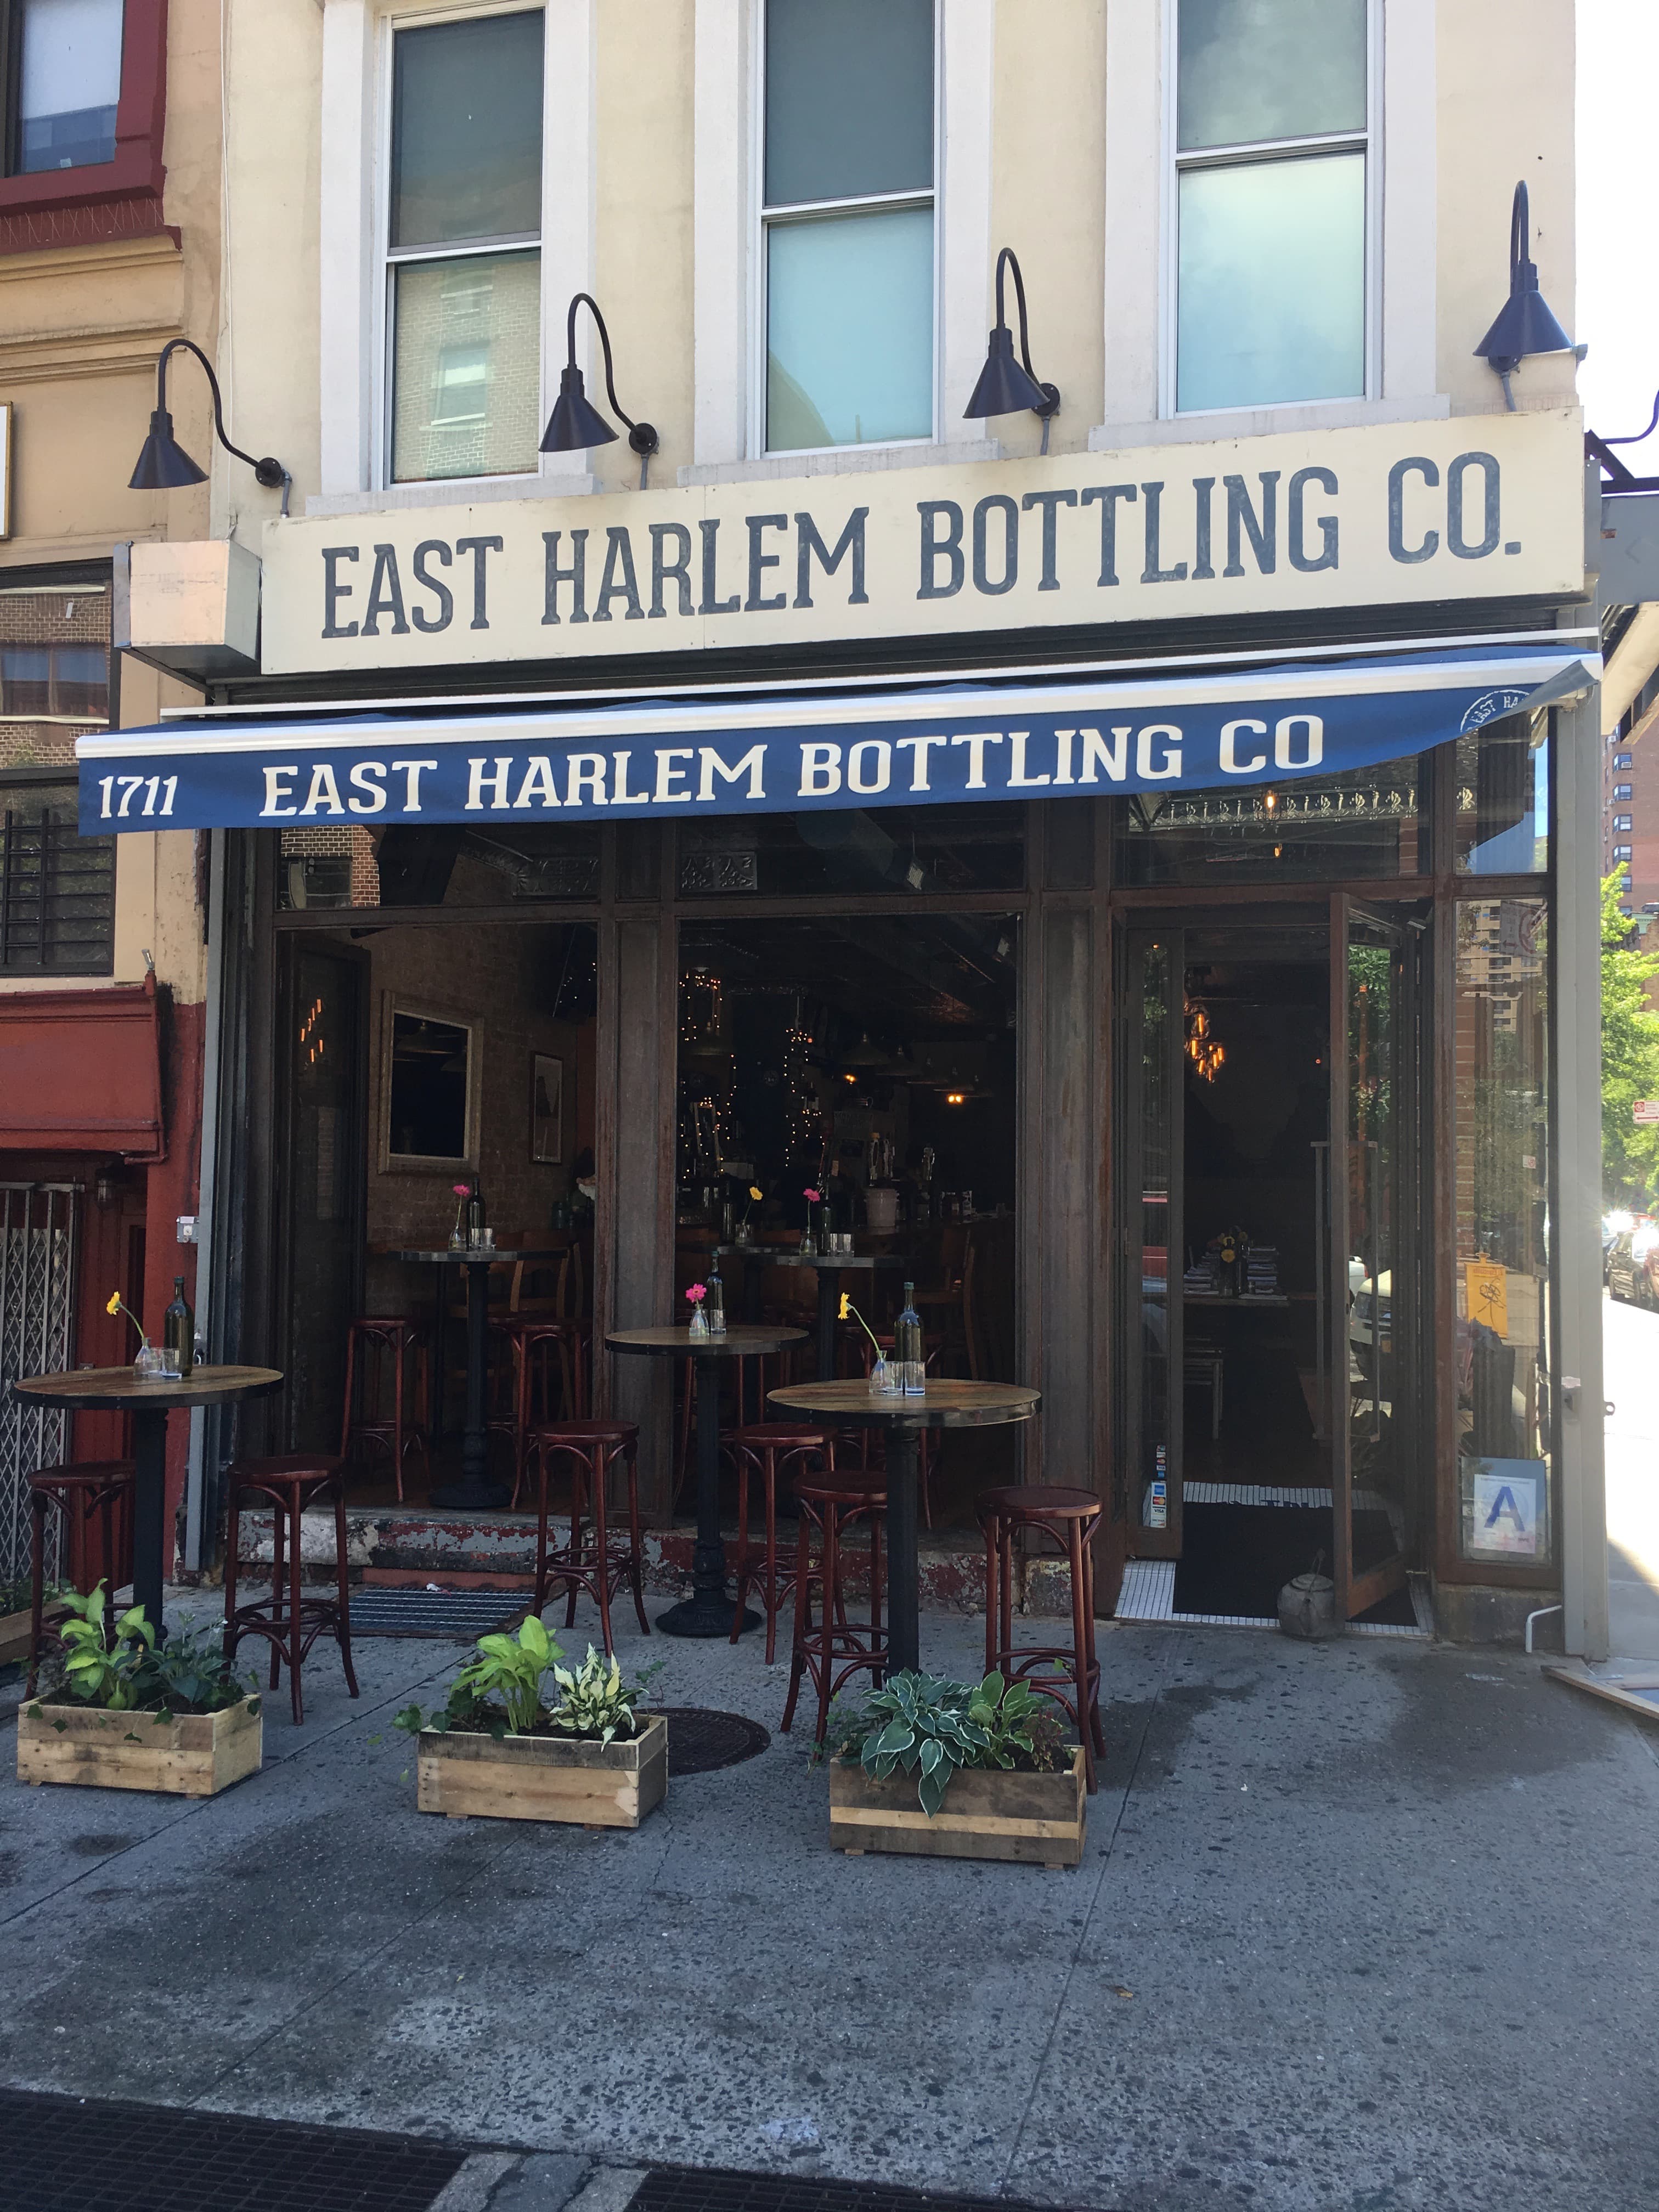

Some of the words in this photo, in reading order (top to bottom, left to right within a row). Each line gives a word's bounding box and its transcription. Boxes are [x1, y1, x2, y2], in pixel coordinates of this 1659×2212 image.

[321, 535, 503, 639] EAST
[541, 507, 870, 625] HARLEM
[916, 466, 1339, 600] BOTTLING
[1388, 451, 1521, 565] CO.
[98, 775, 178, 819] 1711
[258, 760, 438, 817] EAST
[464, 744, 768, 810] HARLEM
[797, 724, 1183, 797] BOTTLING
[1218, 714, 1324, 774] CO
[1484, 1486, 1525, 1532] A
